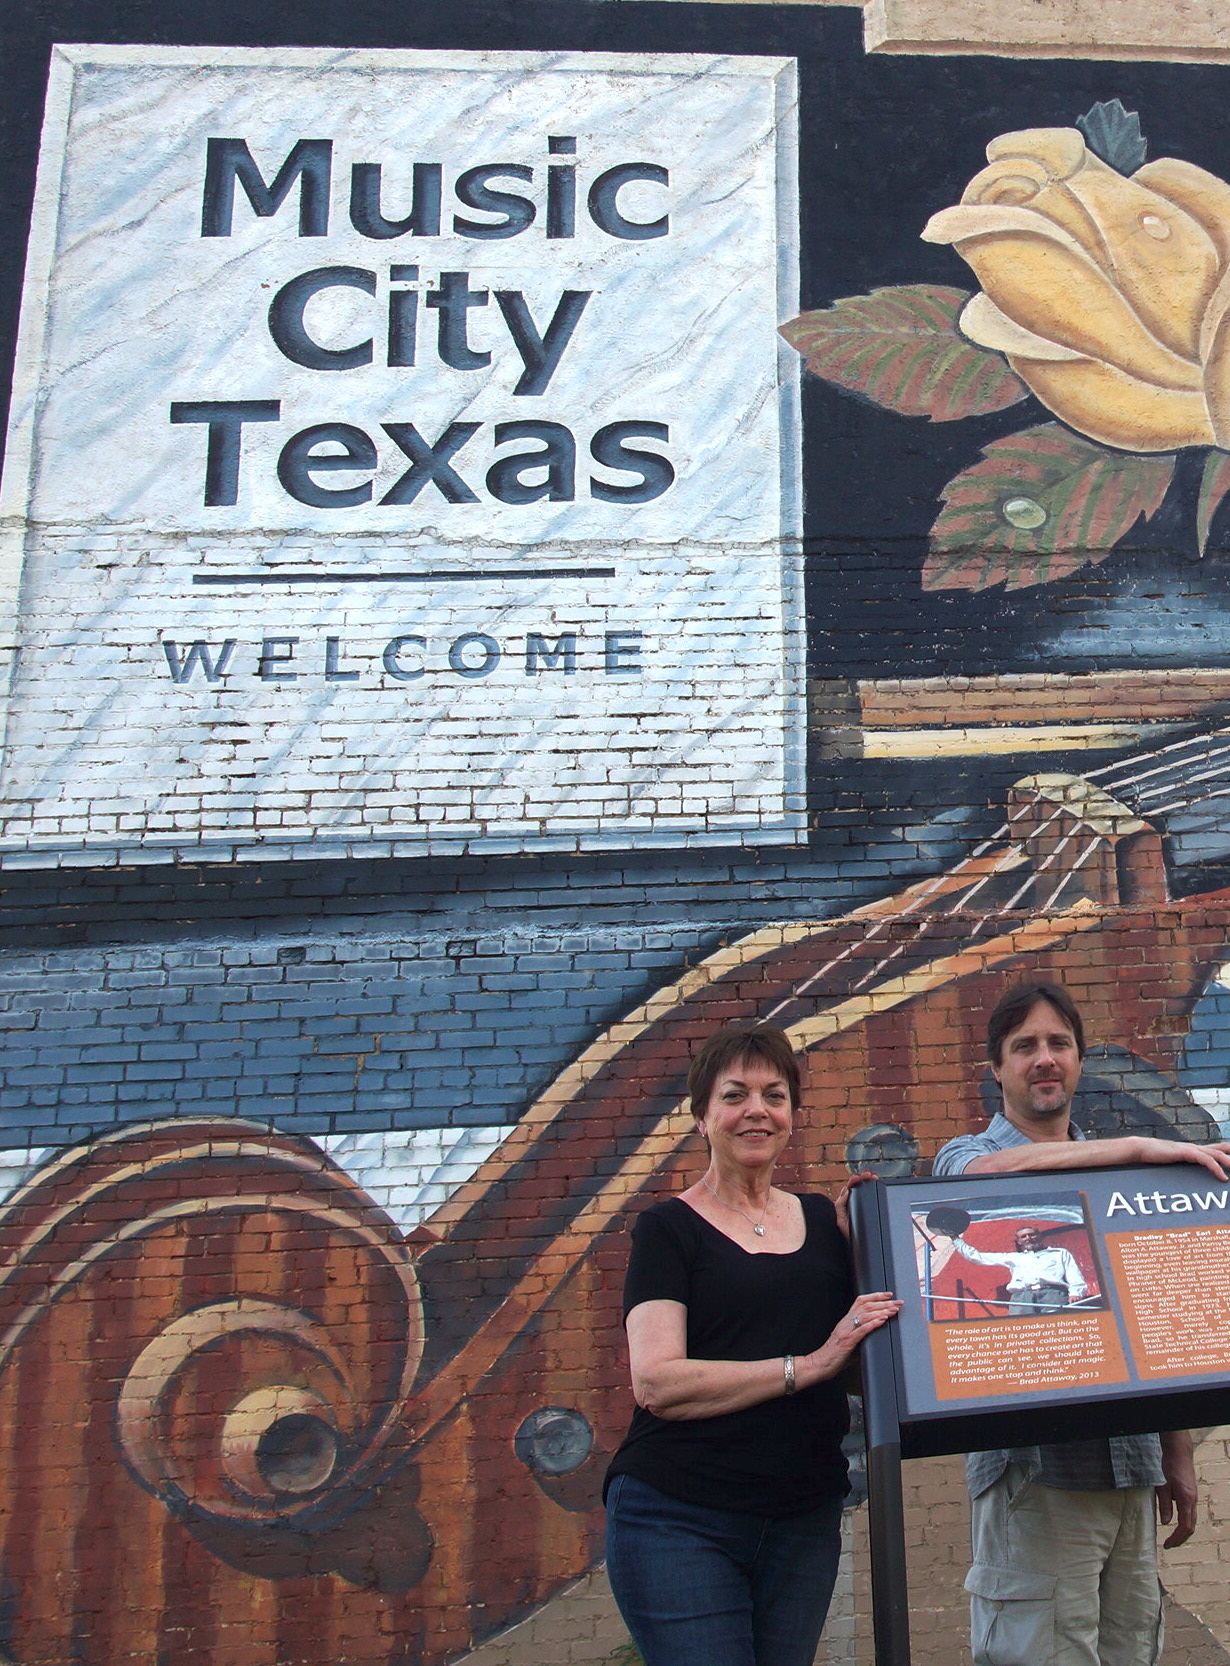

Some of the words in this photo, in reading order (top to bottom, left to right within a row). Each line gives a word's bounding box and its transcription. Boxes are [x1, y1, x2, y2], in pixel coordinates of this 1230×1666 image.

[201, 135, 671, 241] Music
[268, 264, 592, 397] City
[170, 399, 676, 508] Texas
[162, 628, 646, 684] WELCOME
[1019, 1330, 1041, 1339] good
[1006, 1339, 1036, 1348] private
[949, 1365, 996, 1376] advantage
[1026, 1360, 1061, 1368] consider
[966, 1358, 993, 1367] public
[958, 1374, 986, 1382] makes
[1004, 1370, 1024, 1379] stop
